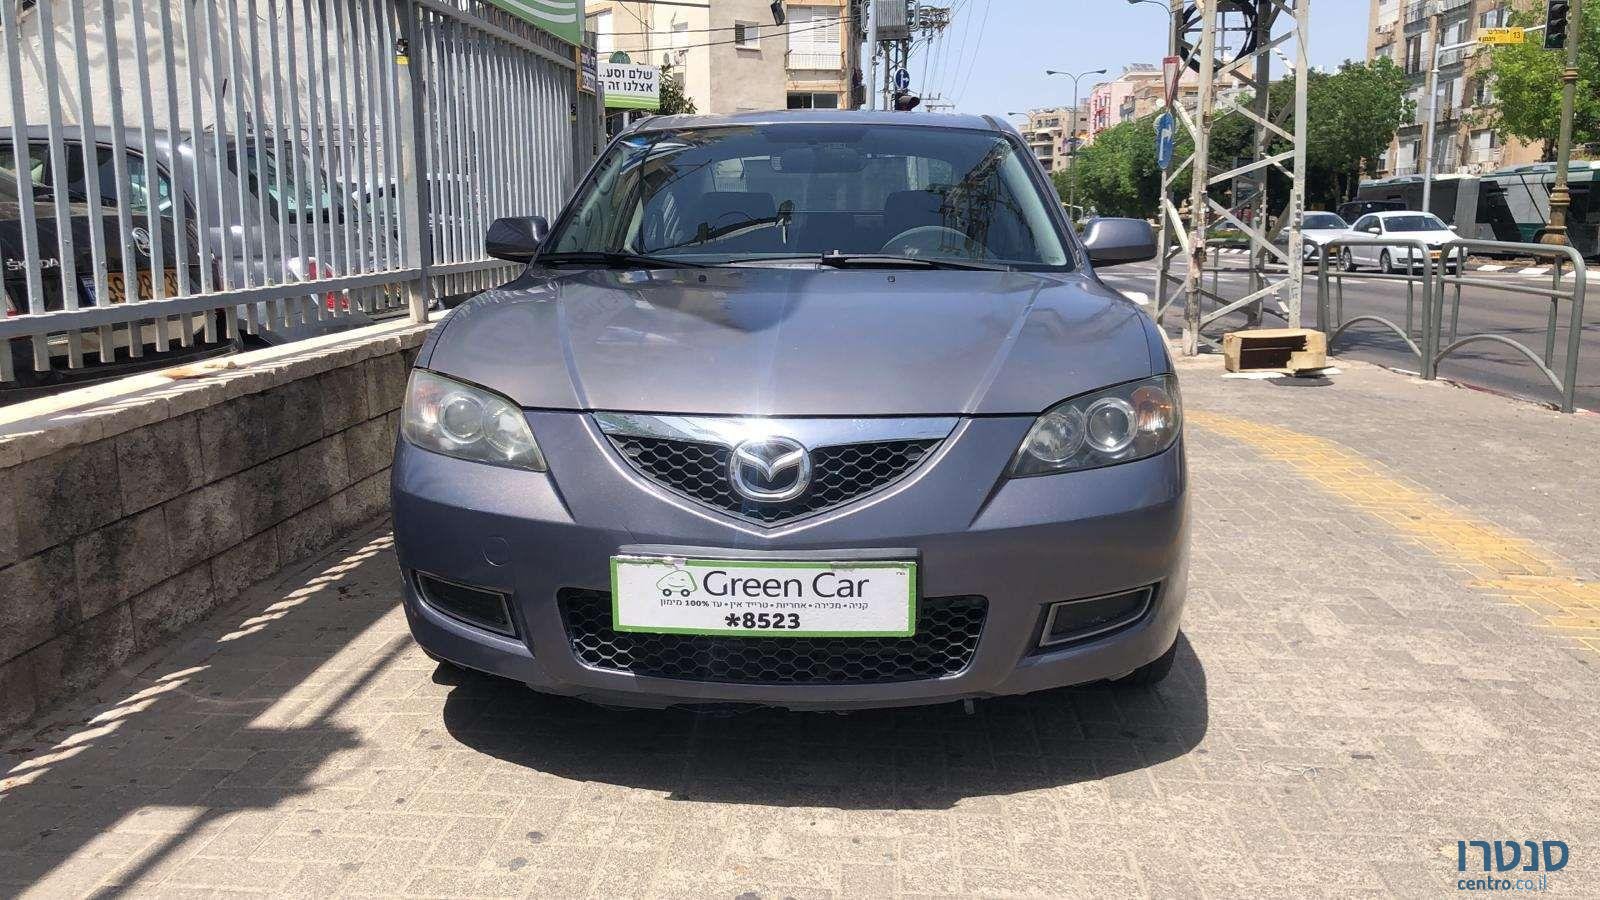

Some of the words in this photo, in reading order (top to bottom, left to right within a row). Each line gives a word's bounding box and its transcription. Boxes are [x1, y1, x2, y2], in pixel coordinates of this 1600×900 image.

[628, 67, 653, 80] שלם
[608, 81, 620, 91] זה
[623, 80, 653, 92] אצלנו
[703, 570, 802, 597] Green
[812, 571, 869, 598] Car
[660, 598, 683, 607] מימון
[712, 600, 723, 608] עד
[730, 601, 743, 609] אין
[848, 602, 869, 610] קניה
